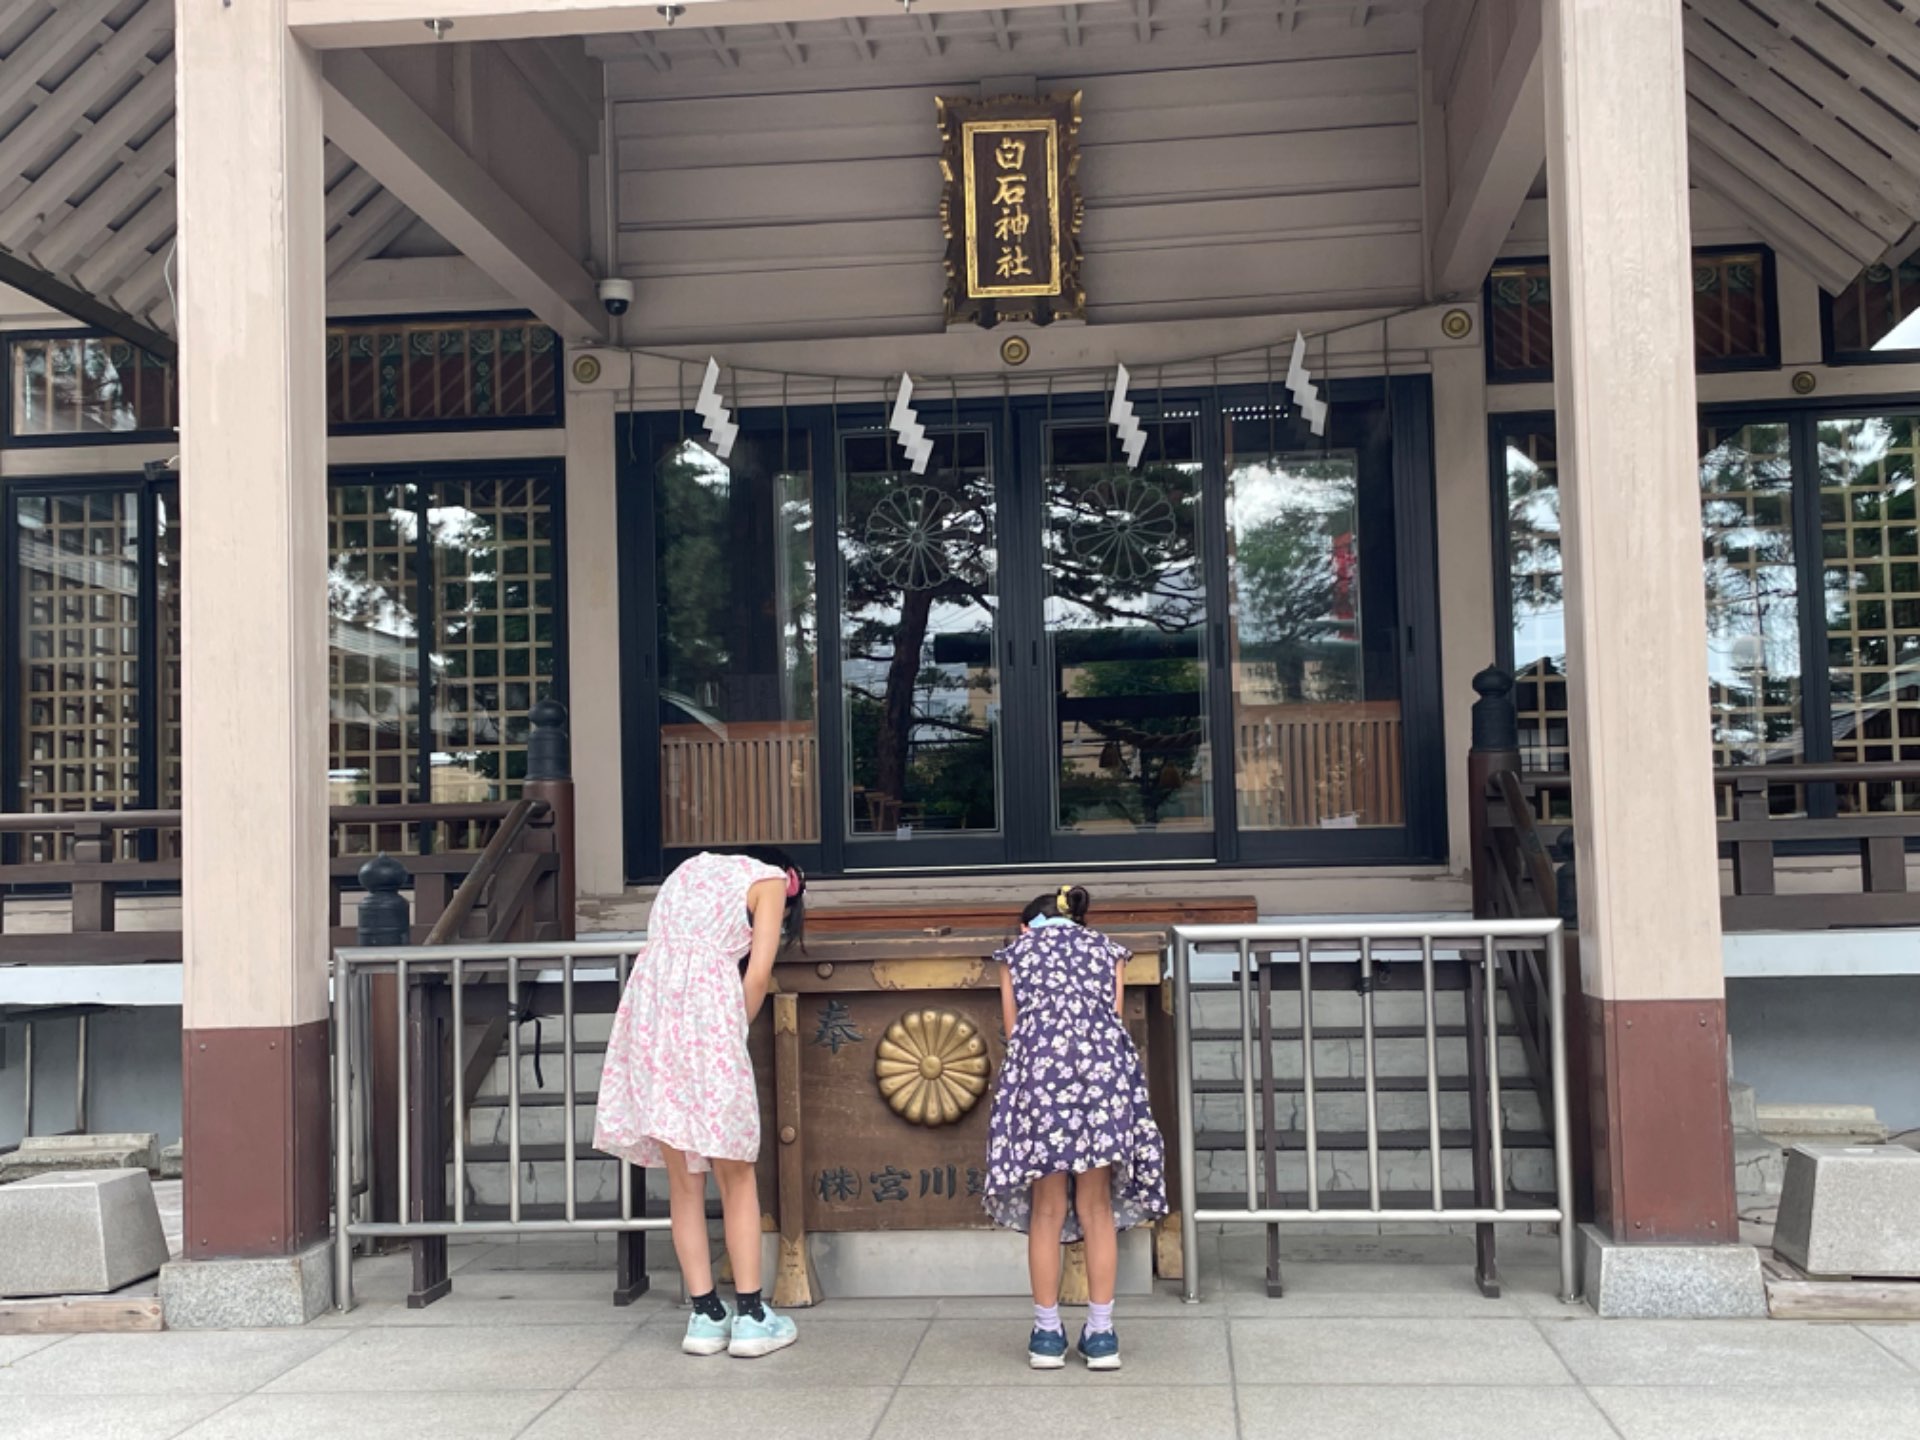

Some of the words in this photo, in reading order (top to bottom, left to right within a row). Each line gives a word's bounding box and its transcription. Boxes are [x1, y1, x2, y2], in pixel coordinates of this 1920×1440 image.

[992, 137, 1033, 278] 白石神社
[813, 1000, 864, 1054] 奉
